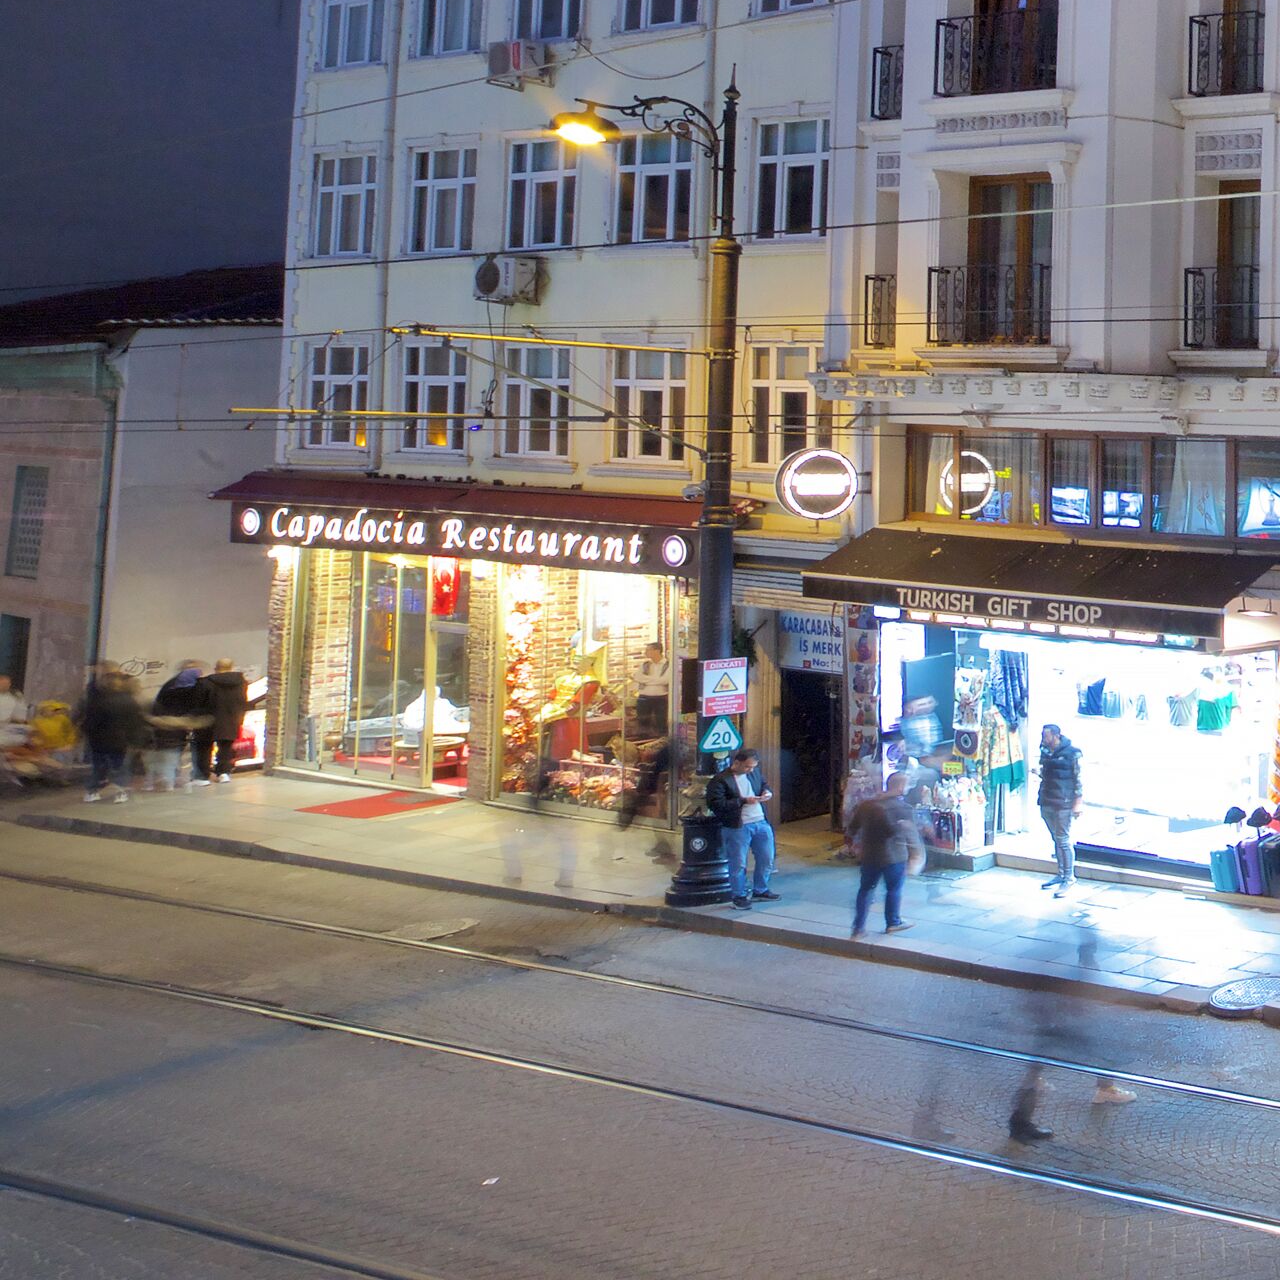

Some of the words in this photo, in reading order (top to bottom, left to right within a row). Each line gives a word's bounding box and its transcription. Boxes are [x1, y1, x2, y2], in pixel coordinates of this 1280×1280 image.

[270, 506, 426, 545] Capadocia
[441, 518, 643, 564] Restaurant
[897, 587, 974, 613] TURKISH
[987, 596, 1032, 618] GIFT
[1047, 602, 1102, 624] SHOP
[711, 731, 731, 745] 20
